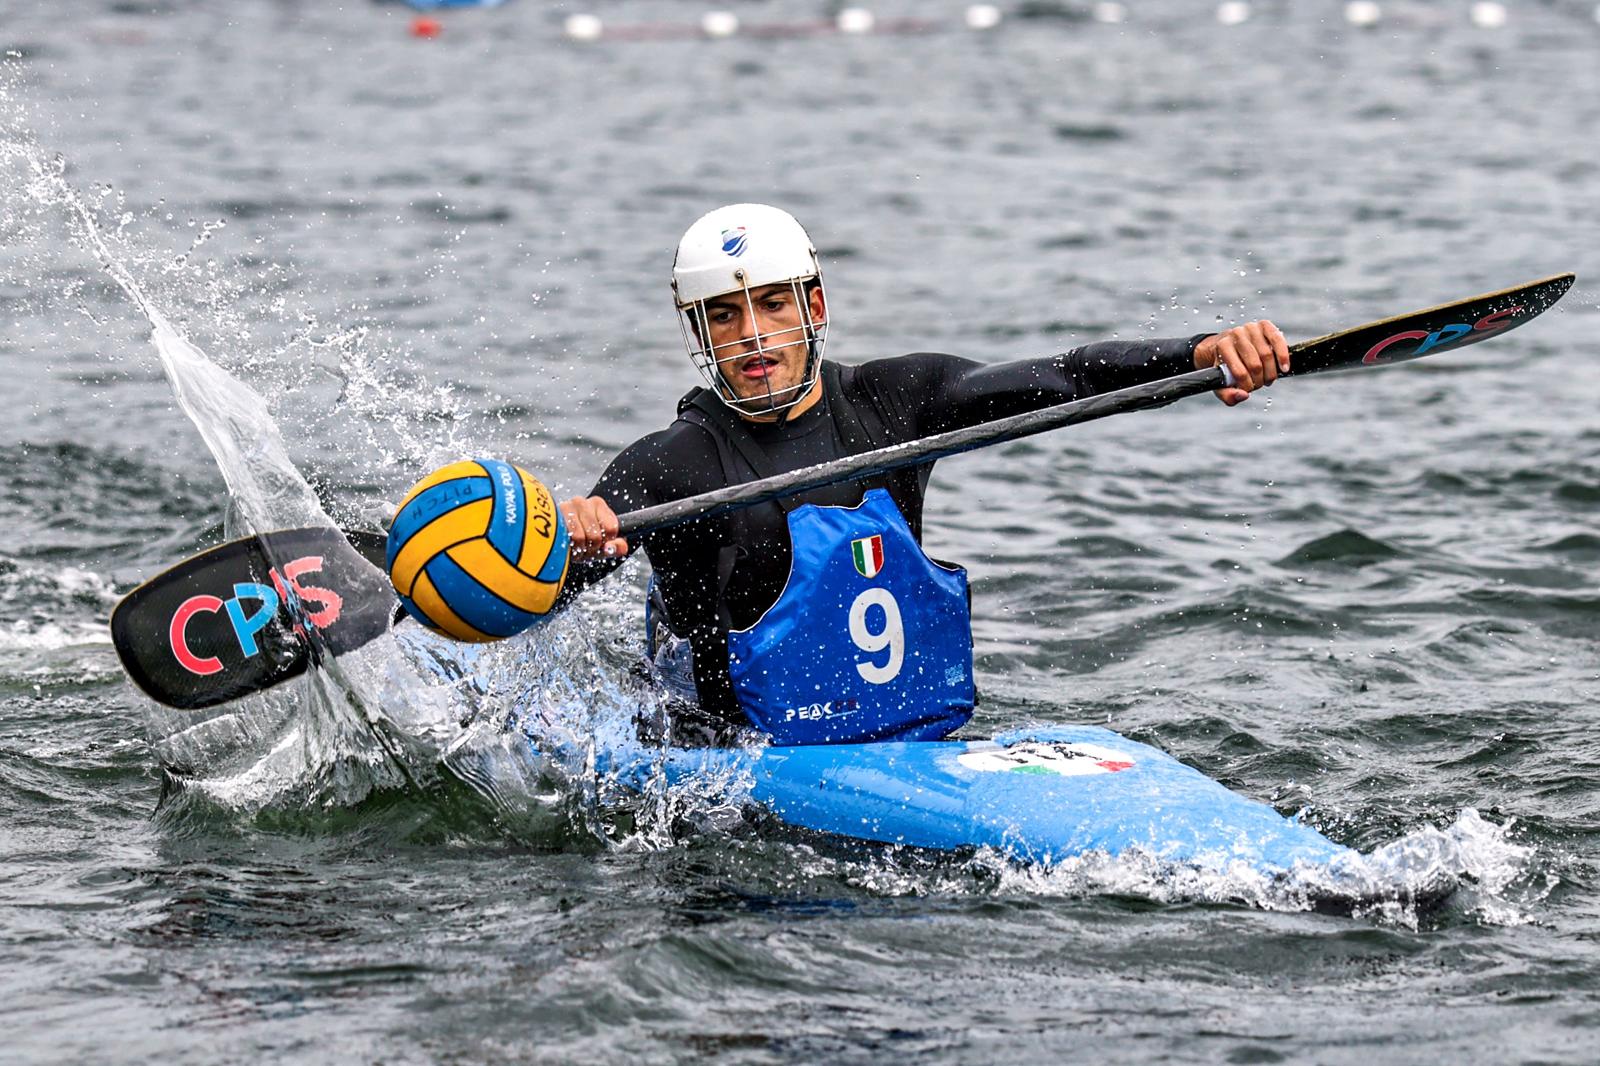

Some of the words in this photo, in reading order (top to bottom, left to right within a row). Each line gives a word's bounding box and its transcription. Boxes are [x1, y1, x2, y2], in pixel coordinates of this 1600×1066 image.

[1362, 304, 1523, 365] CPS
[497, 465, 514, 487] POLO
[412, 484, 473, 520] PITCH
[505, 488, 517, 524] KAYAK
[169, 556, 343, 676] CPS
[848, 587, 905, 685] 9
[785, 701, 833, 722] PEAK
